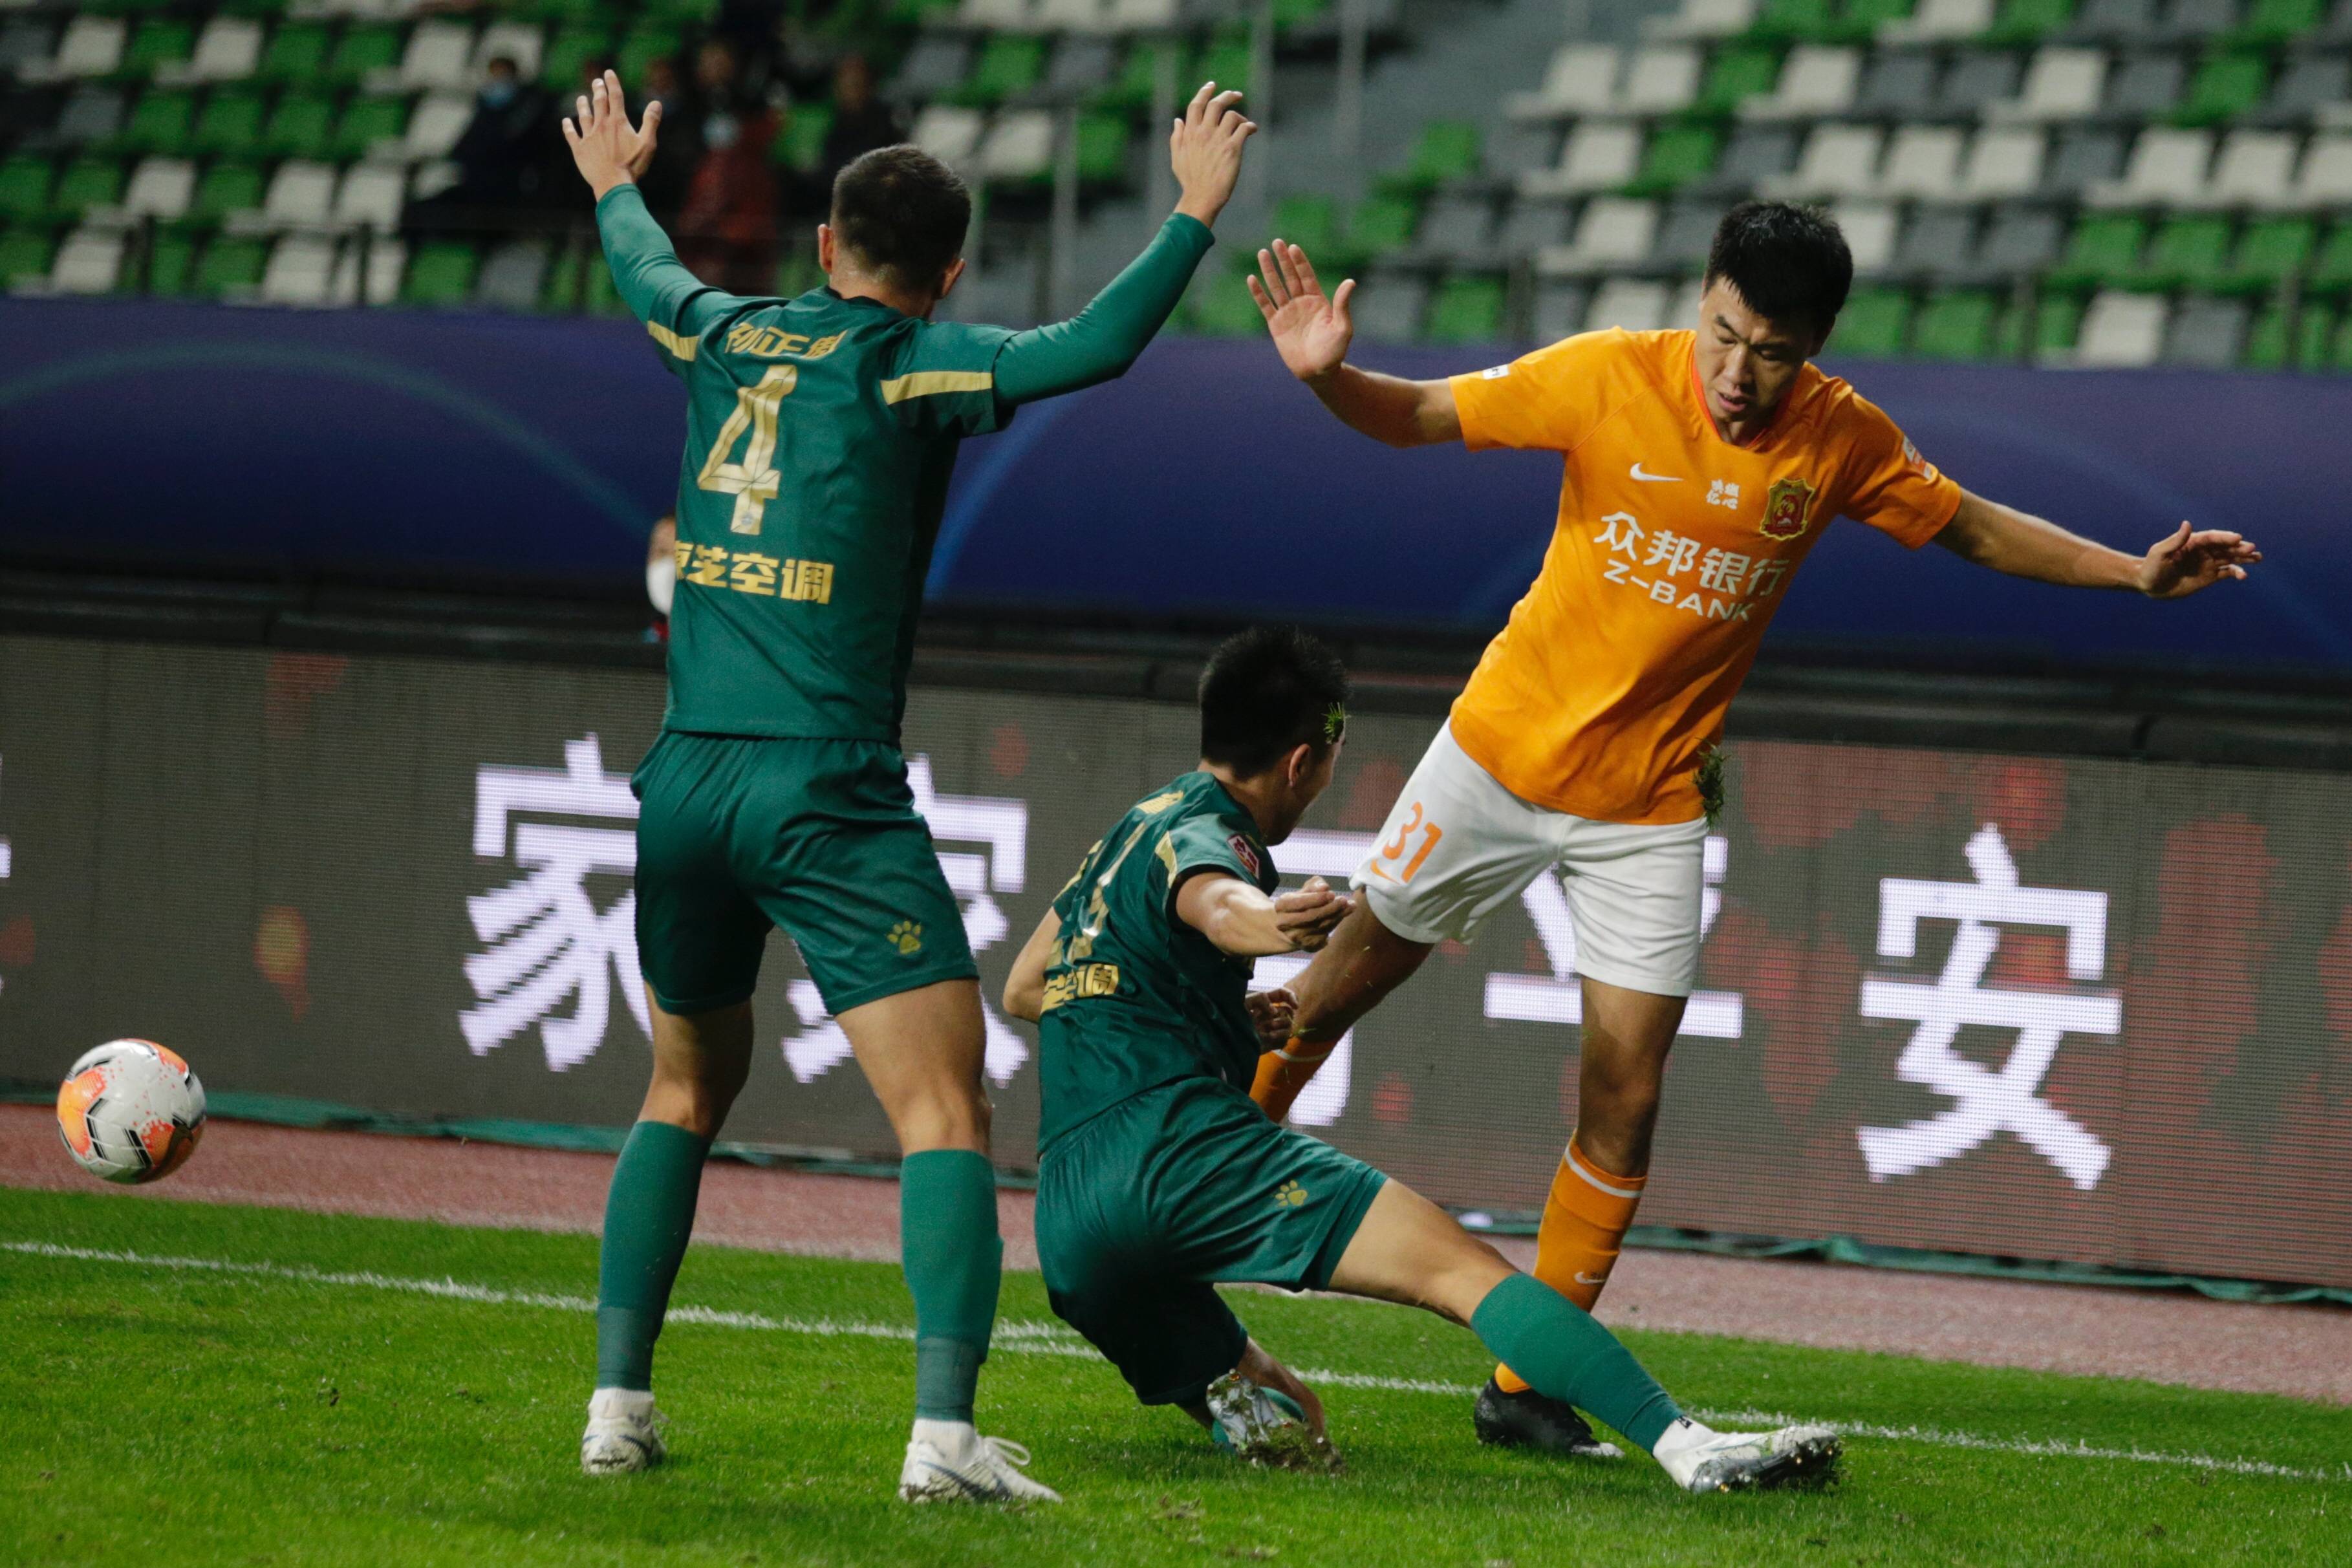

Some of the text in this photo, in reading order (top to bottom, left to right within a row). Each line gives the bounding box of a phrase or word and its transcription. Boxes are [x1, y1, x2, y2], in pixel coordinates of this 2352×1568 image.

[698, 364, 797, 535] 4
[1593, 511, 1790, 596] 众邦银行
[1603, 559, 1754, 621] Z-BANK
[1382, 801, 1442, 883] 31
